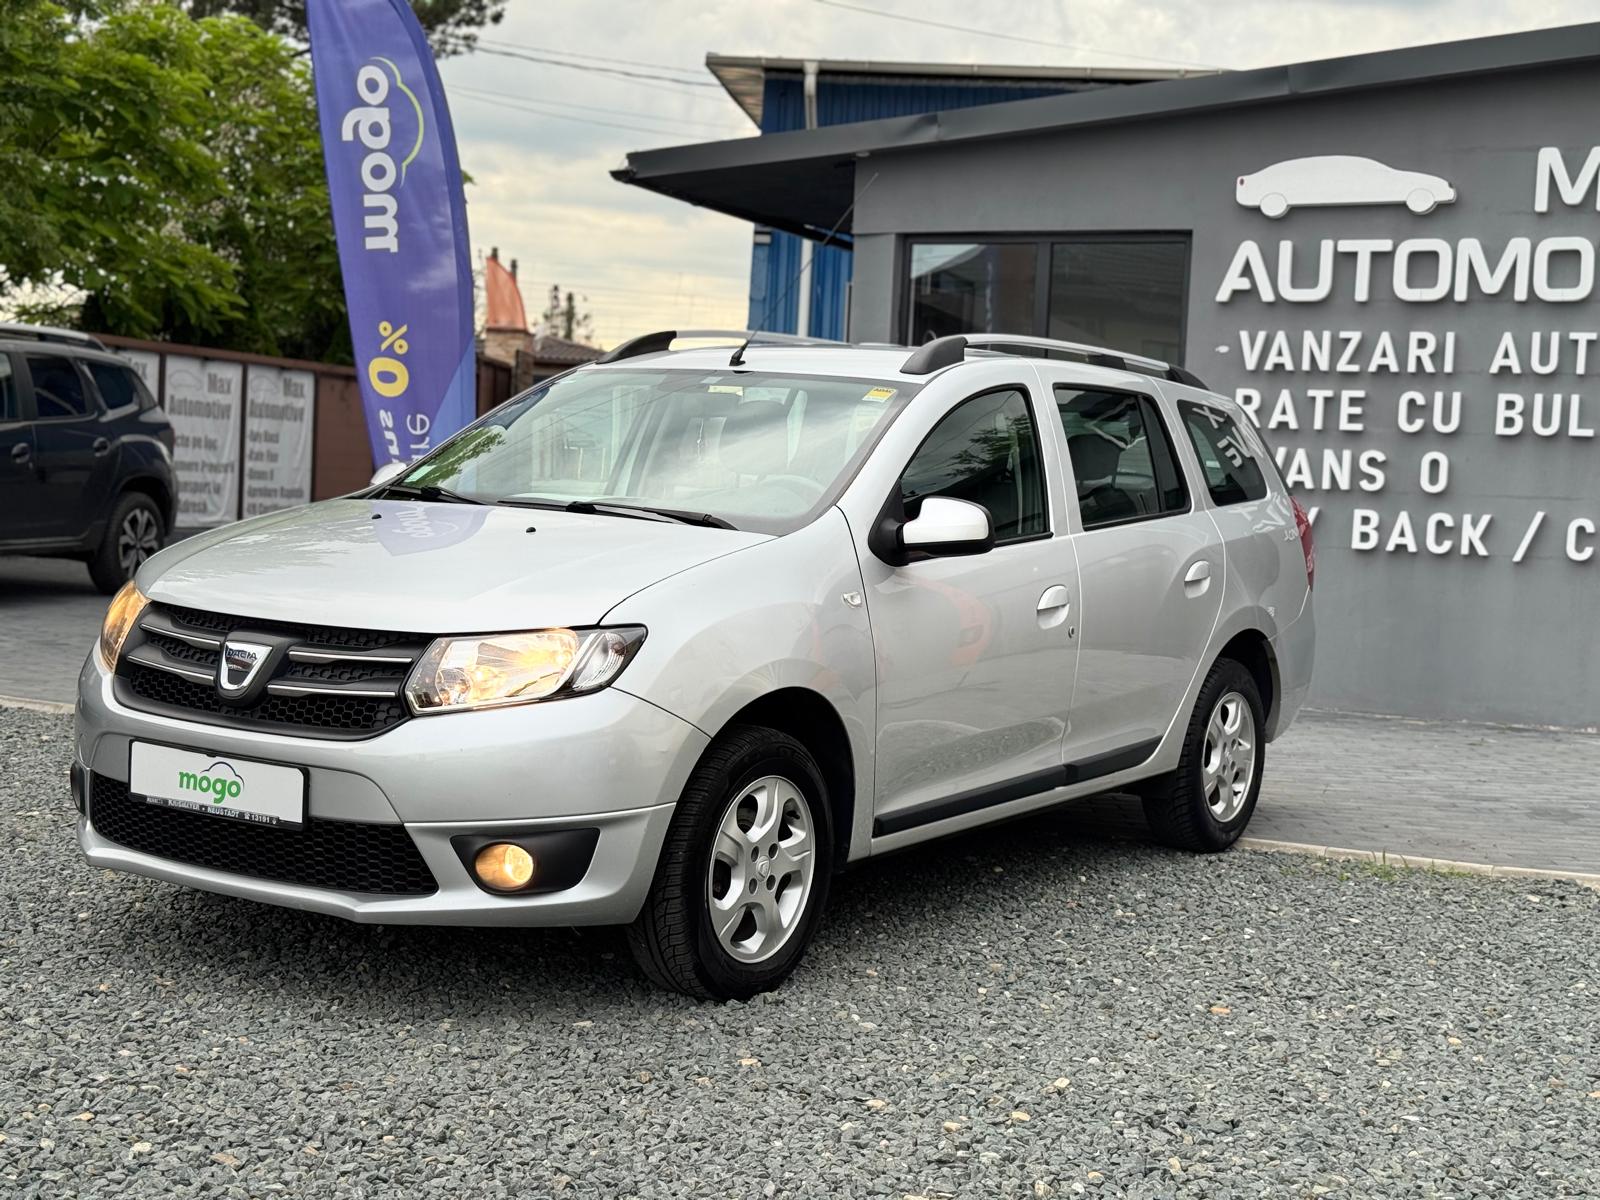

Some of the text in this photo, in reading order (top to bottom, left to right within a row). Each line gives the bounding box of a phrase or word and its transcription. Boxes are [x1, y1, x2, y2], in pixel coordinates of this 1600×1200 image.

[342, 65, 398, 253] mogo
[1215, 237, 1595, 302] AUTOMO
[369, 320, 409, 398] 0%
[1489, 331, 1598, 375] AUT
[1234, 388, 1595, 437] RATE CU BUL
[1351, 508, 1492, 557] BACK
[226, 648, 257, 660] DACIA
[179, 771, 241, 804] mogo
[207, 806, 240, 818] NEUSTADT
